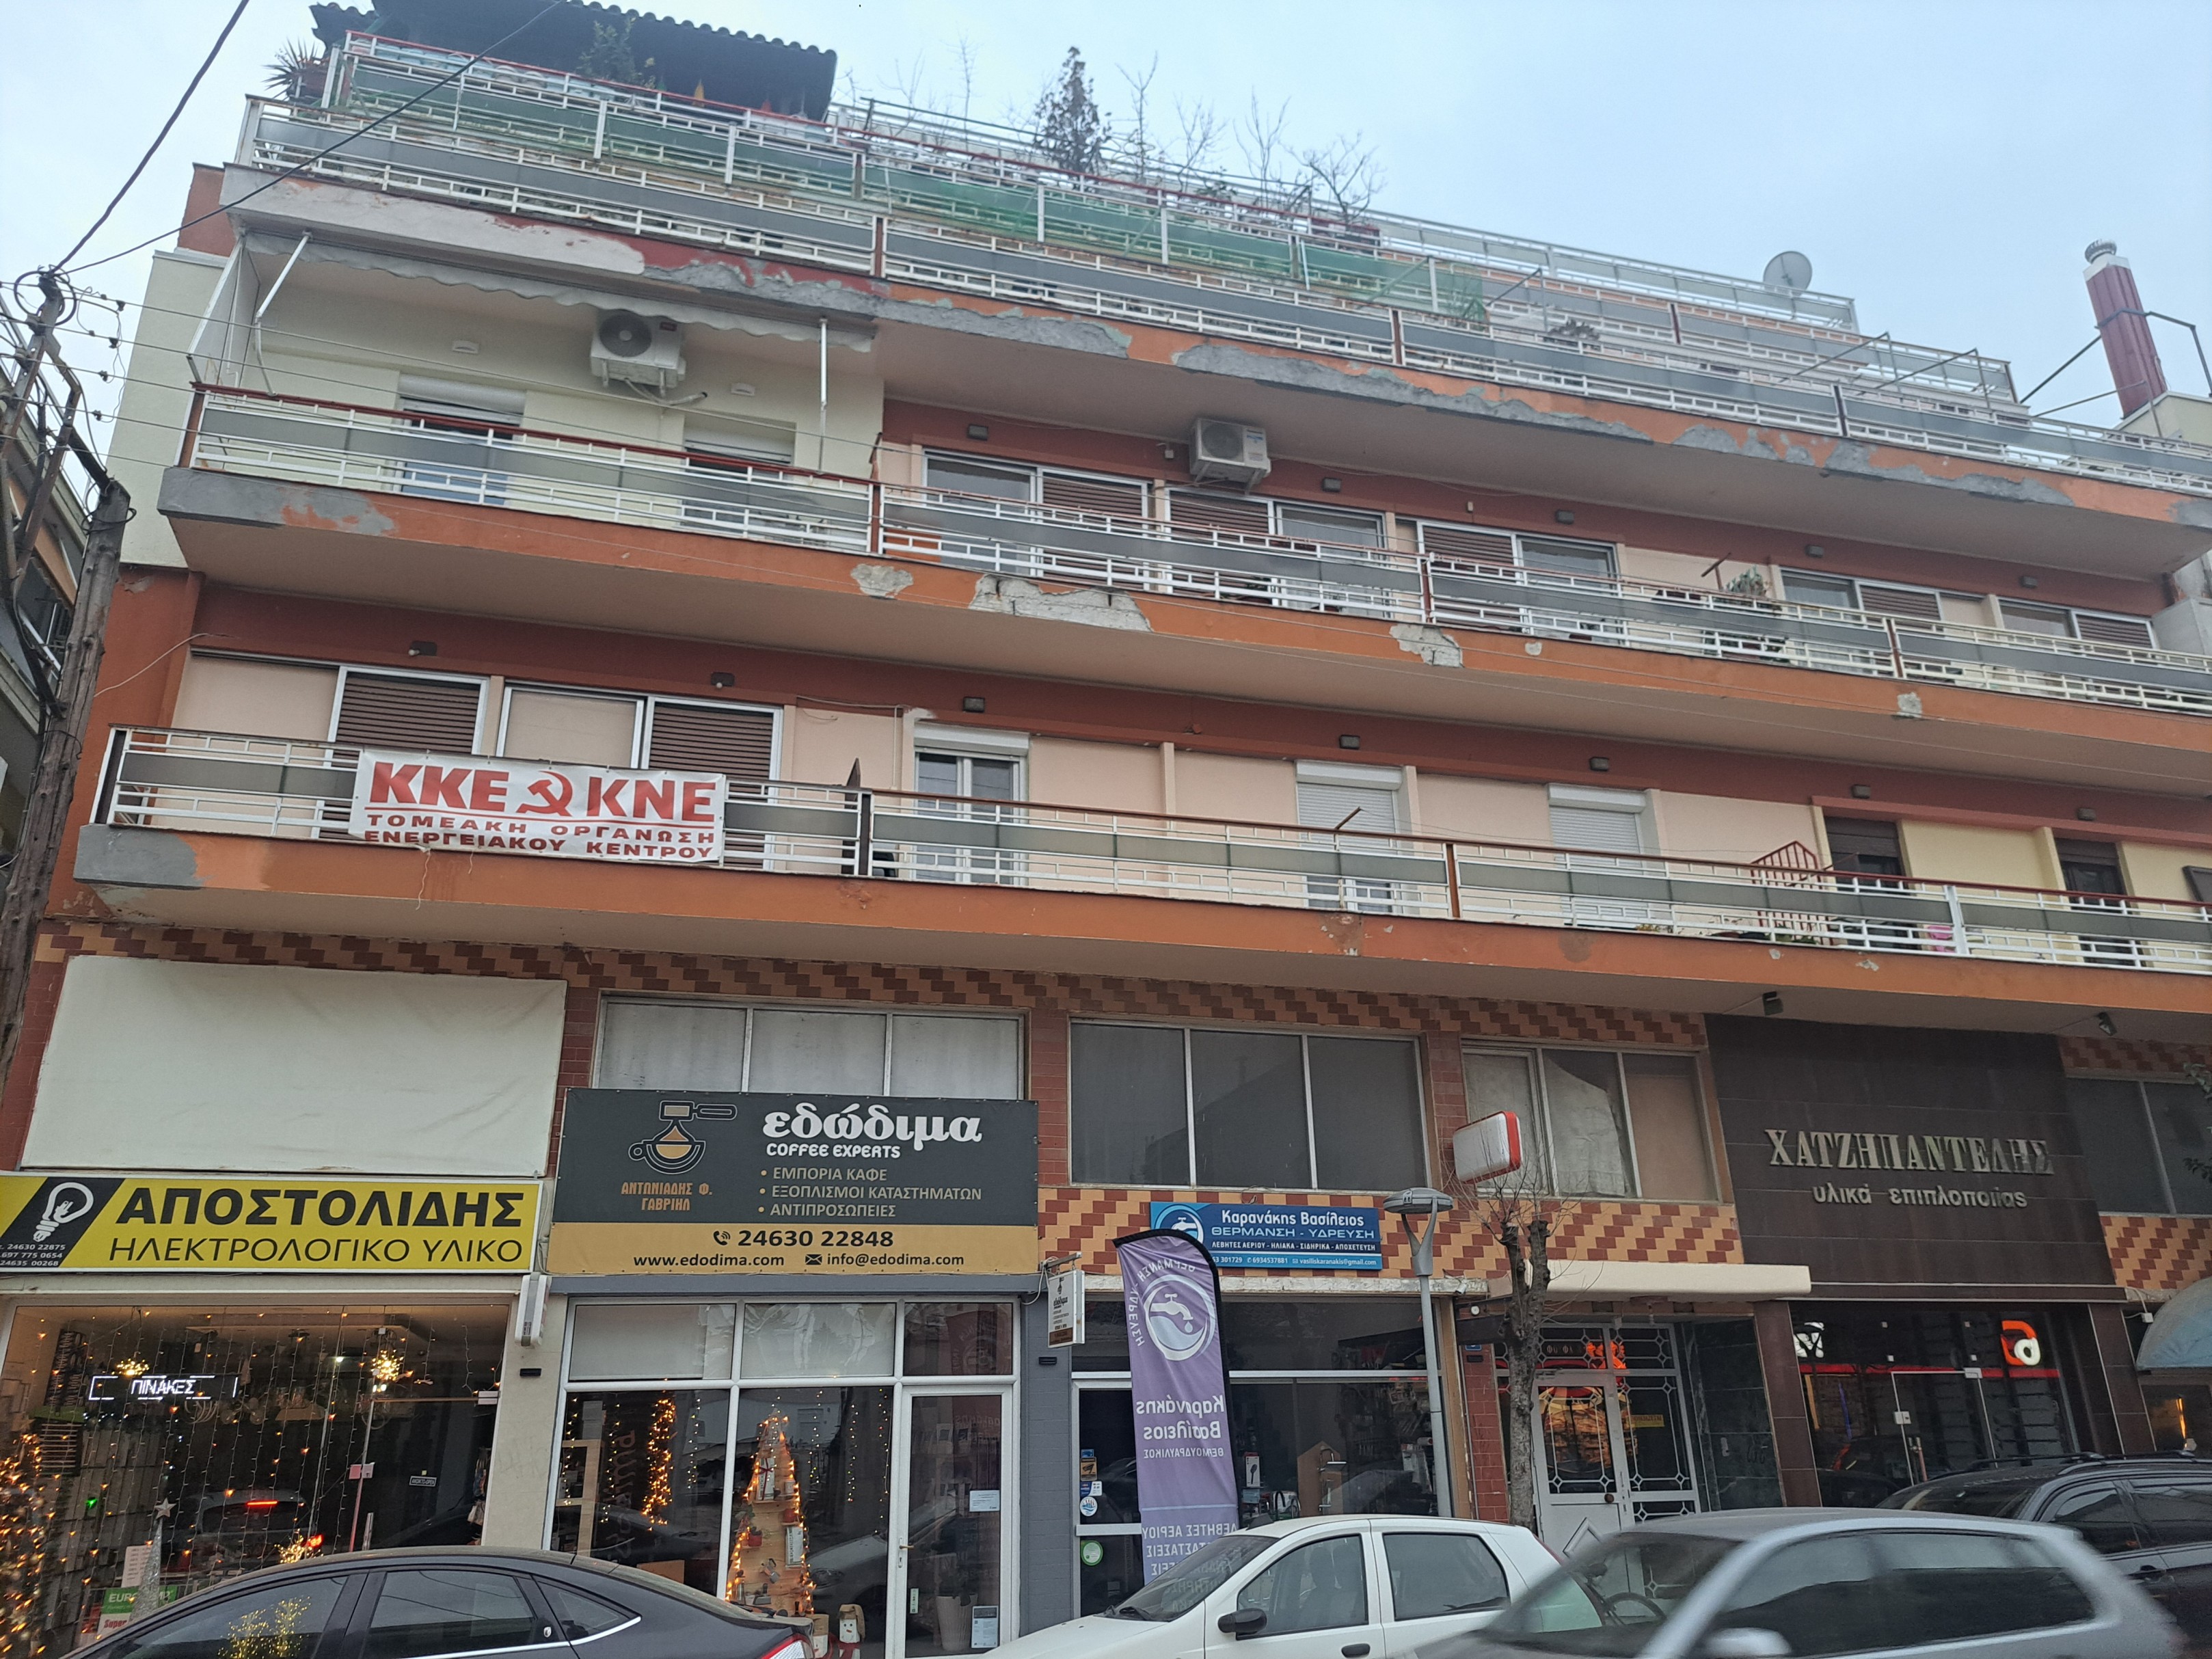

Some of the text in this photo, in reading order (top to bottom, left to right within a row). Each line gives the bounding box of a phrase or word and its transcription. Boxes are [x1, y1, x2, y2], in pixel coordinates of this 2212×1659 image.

[367, 814, 714, 844] ΤΟΜΕΑΚΗ ΟΡΓΑΝΩΣΗ
[364, 830, 712, 859] ΕΝΕΡΓΕΙΑΚΟΥ ΚΕΝΤΡΟΥ
[762, 1102, 982, 1151] εδώδιμα
[766, 1142, 901, 1159] COFFEE EXPERTS
[1765, 1129, 2054, 1175] ΧΑΤΖΗΠΑΝΤΕΛΗΣ
[772, 1167, 887, 1181] ΕΜΠΟΡΙΑ ΚΑΦΕ
[621, 1182, 713, 1196] ΑΝΤΩΝΙΑΔΗΣ Φ.
[771, 1185, 982, 1200] ΕΞΟΠΛΙΣΜΟΙ ΚΑΤΑΣΤΗΜΑΤΩΝ
[1813, 1183, 1872, 1205] υλικά
[116, 1188, 524, 1227] ΑΠΟΣΤΟΛΙΔΗΣ
[641, 1198, 690, 1211] ΓΑΒΡΙΗΛ
[770, 1204, 897, 1217] ΑΝΤΙΠΡΟΣΩΠΕΙΕΣ
[1222, 1210, 1364, 1226] Καρανάκης Βασίλειος
[738, 1230, 893, 1247] 24630 22848
[1211, 1227, 1296, 1237] ΘΕΡΜΑΝΣΗ
[1308, 1229, 1375, 1239] ΥΔΡΕΥΣΗ
[108, 1238, 523, 1263] ΗΛΕΚΤΡΟΛΟΓΙΚΟ ΥΛΙΚΟ
[1335, 1243, 1376, 1252] ΑΠΟΧΕΤΕΥΣΗ
[634, 1253, 965, 1267] www.edodima.com info@edodima.com
[131, 1379, 196, 1394] ΠΙΝΑΚΕΣ
